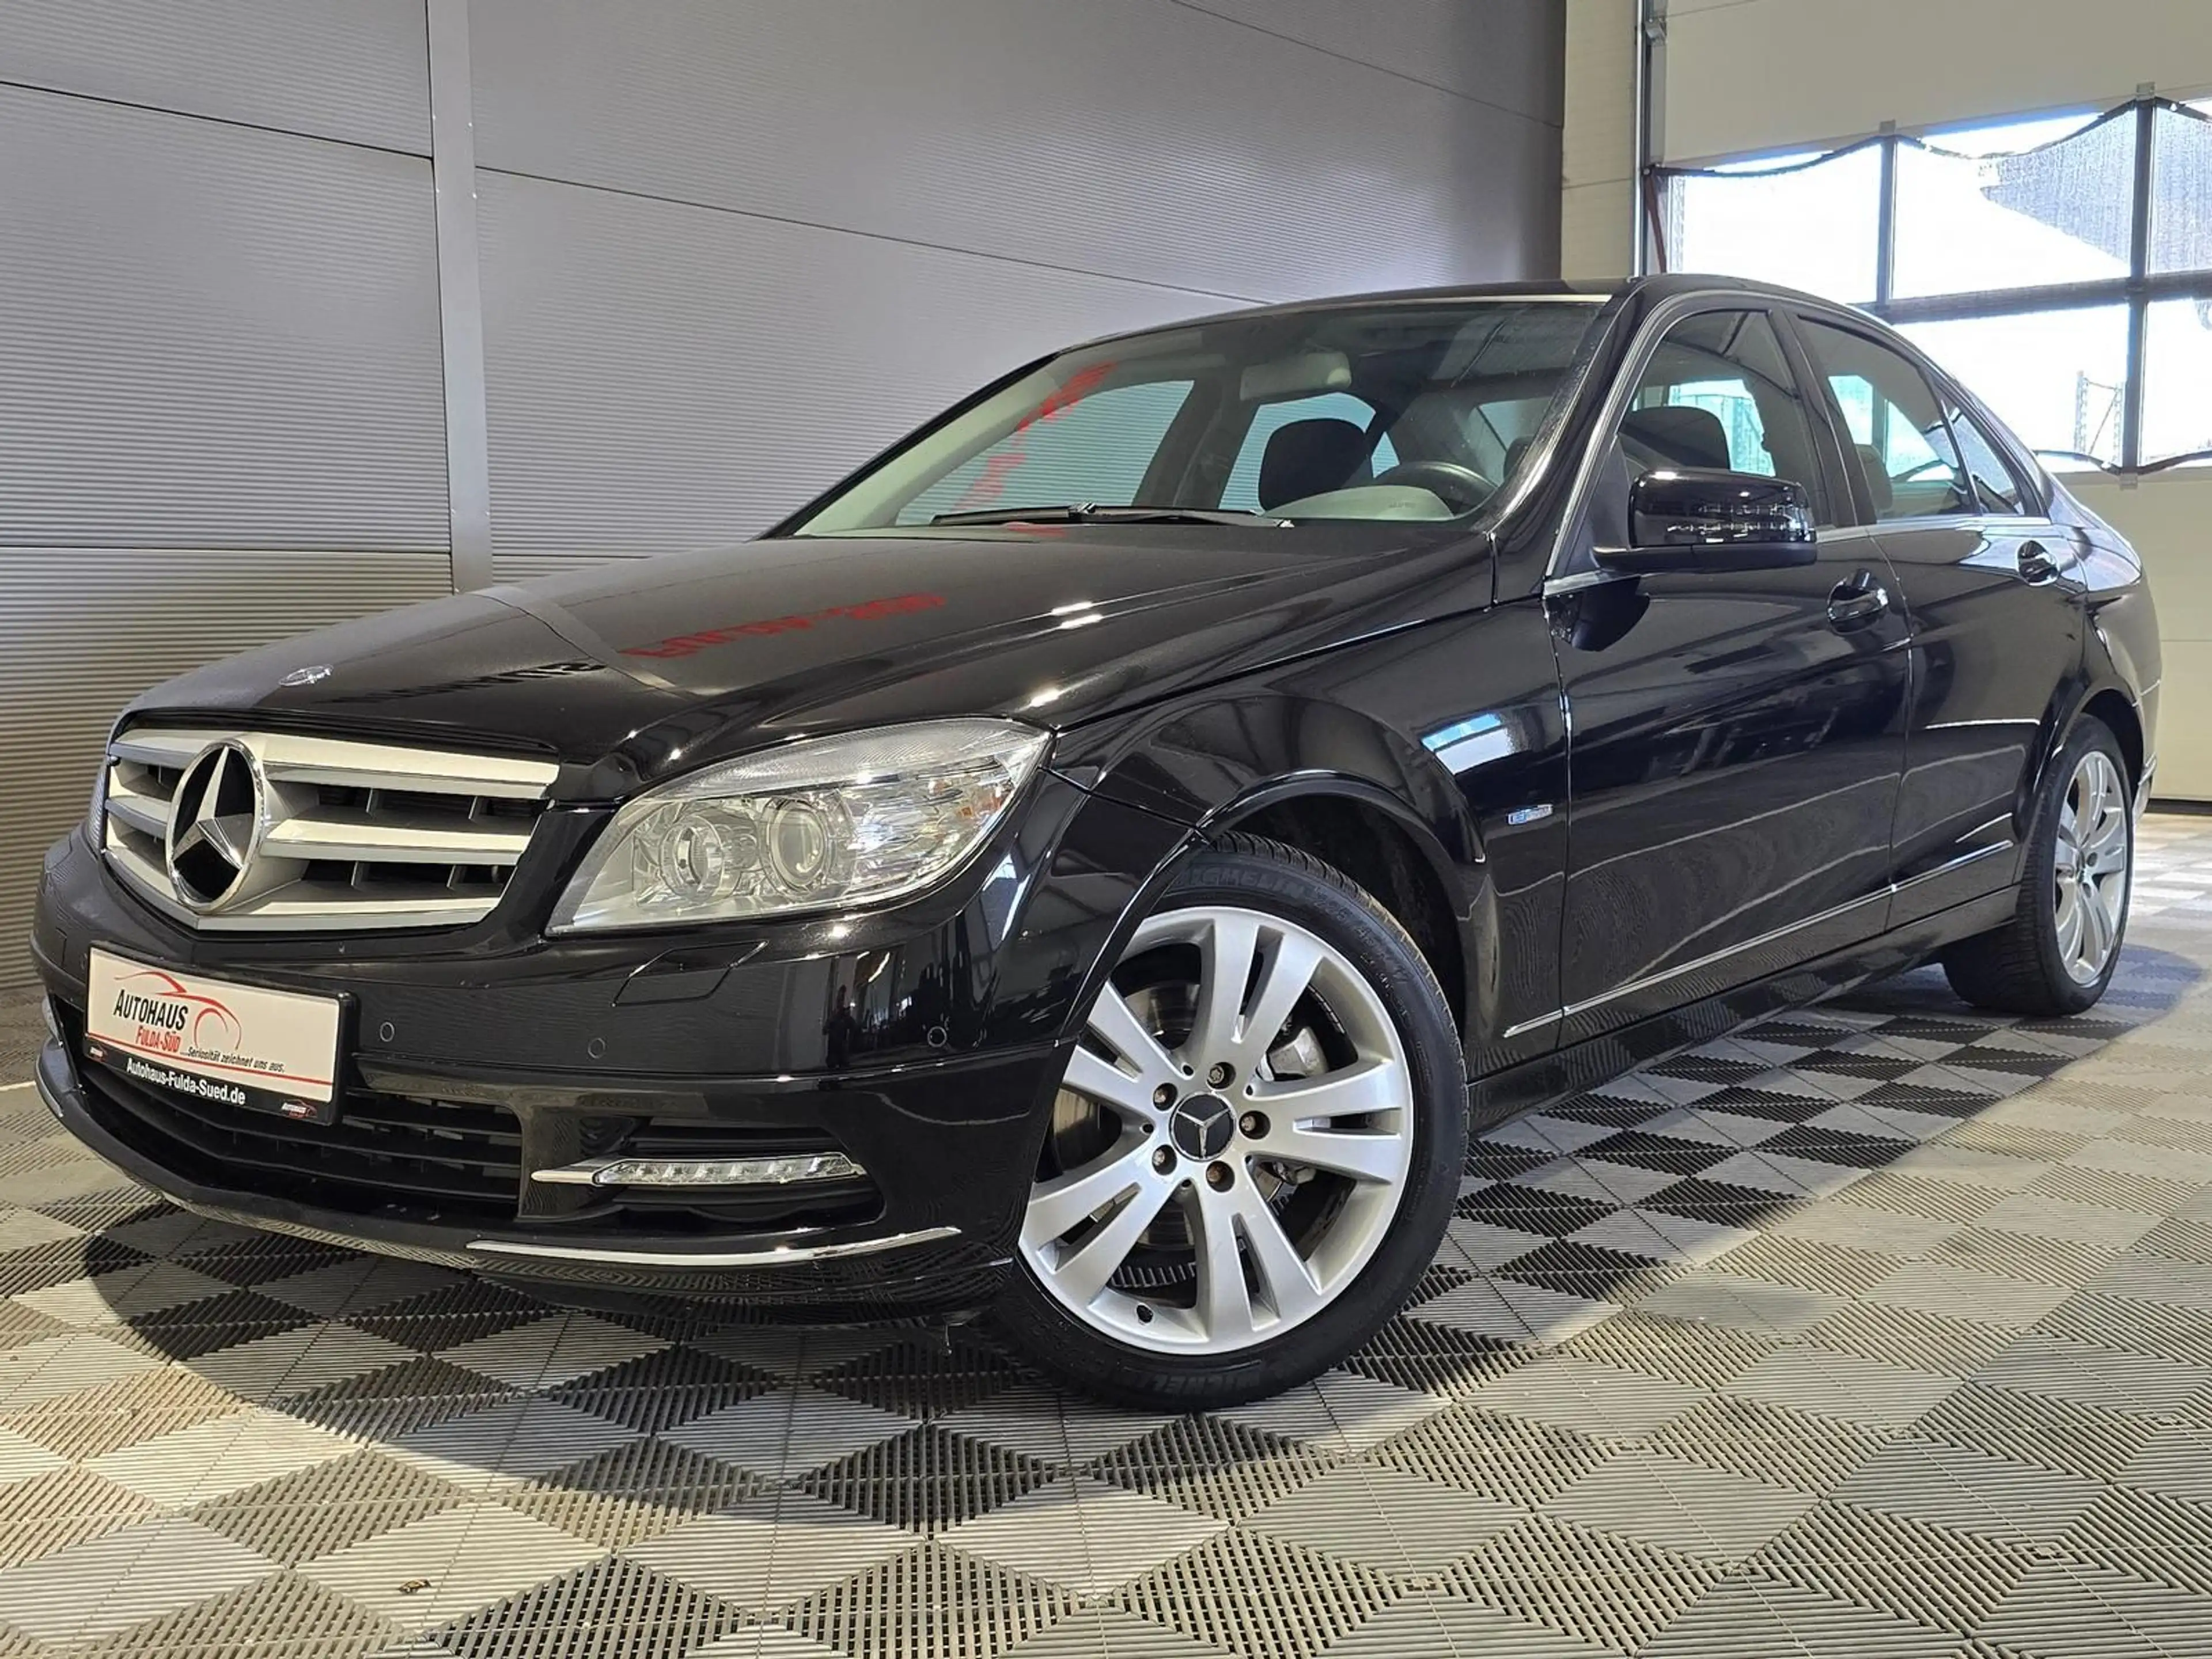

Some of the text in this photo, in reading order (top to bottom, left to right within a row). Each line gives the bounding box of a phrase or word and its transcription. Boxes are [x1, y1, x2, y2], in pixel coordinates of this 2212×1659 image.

[113, 989, 188, 1031] AUTOHAUS
[135, 1025, 181, 1052] FULDA-SÜD
[127, 1058, 245, 1104] Autohaus-Fulda-Sued.de
[254, 1059, 268, 1070] uns
